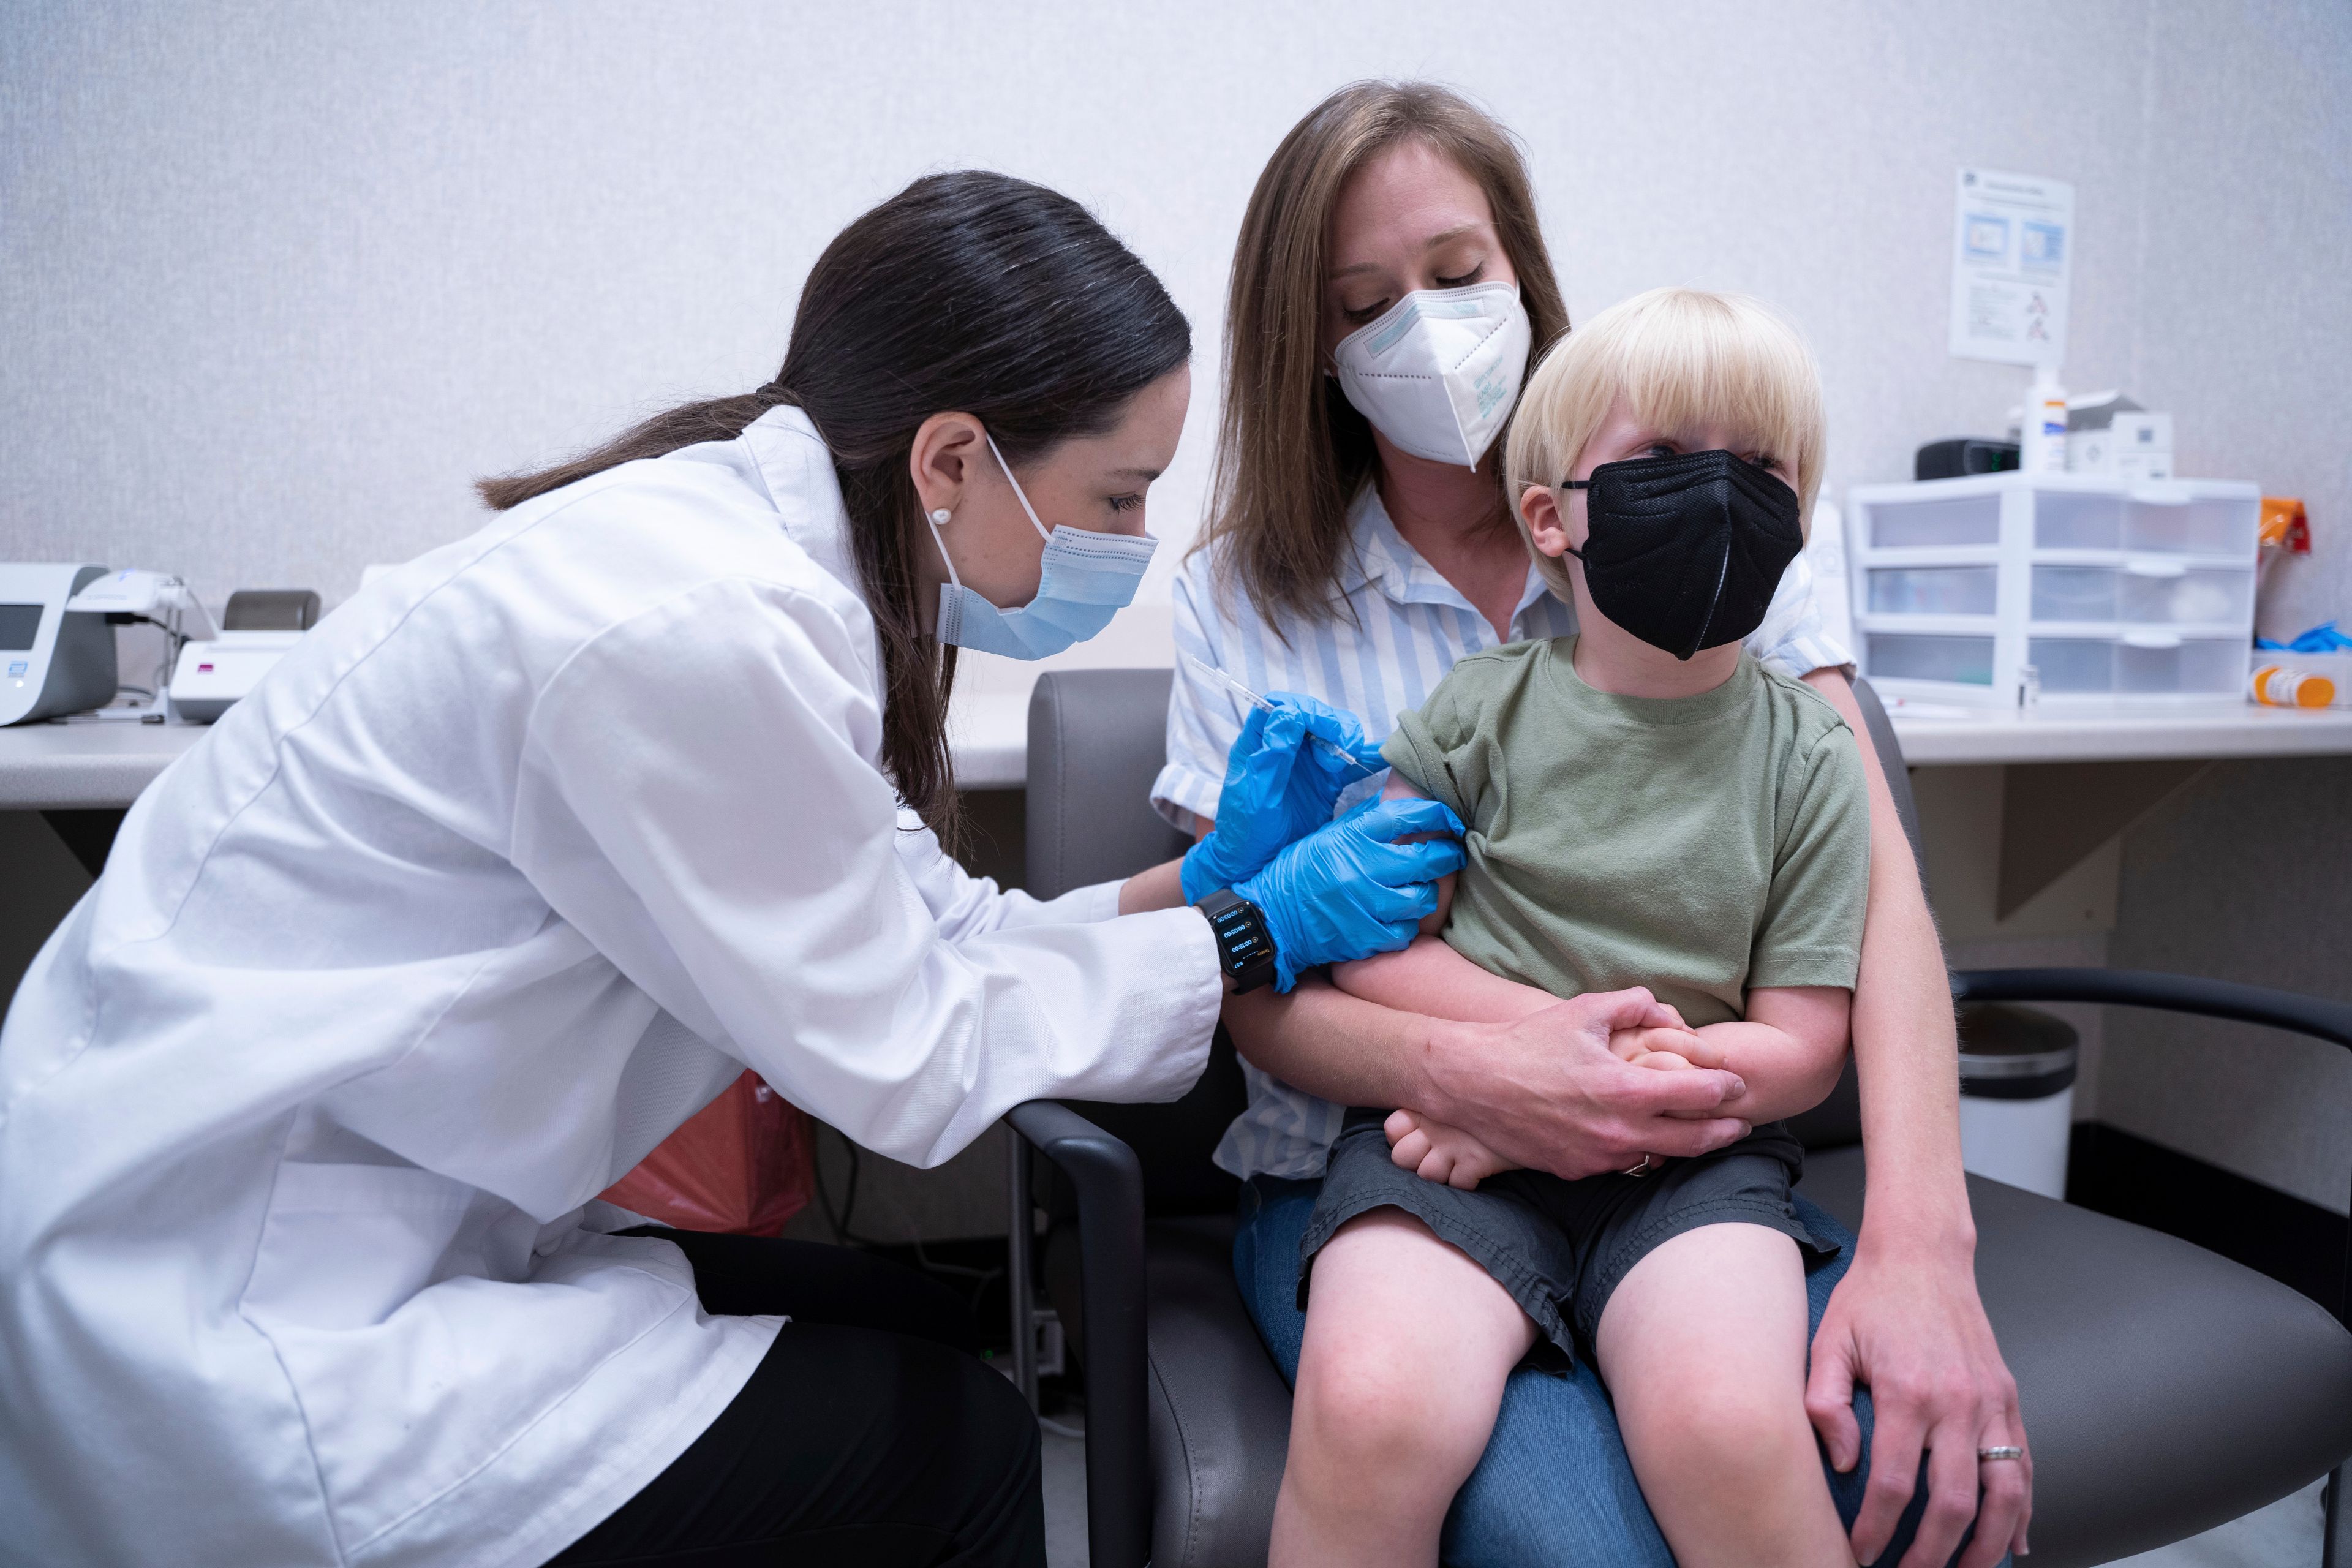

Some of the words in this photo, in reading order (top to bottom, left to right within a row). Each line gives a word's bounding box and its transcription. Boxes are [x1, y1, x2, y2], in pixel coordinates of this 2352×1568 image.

[1217, 910, 1238, 923] 00:03:00
[1224, 924, 1245, 938] 00:05:00
[1232, 940, 1252, 952] 00:15:00
